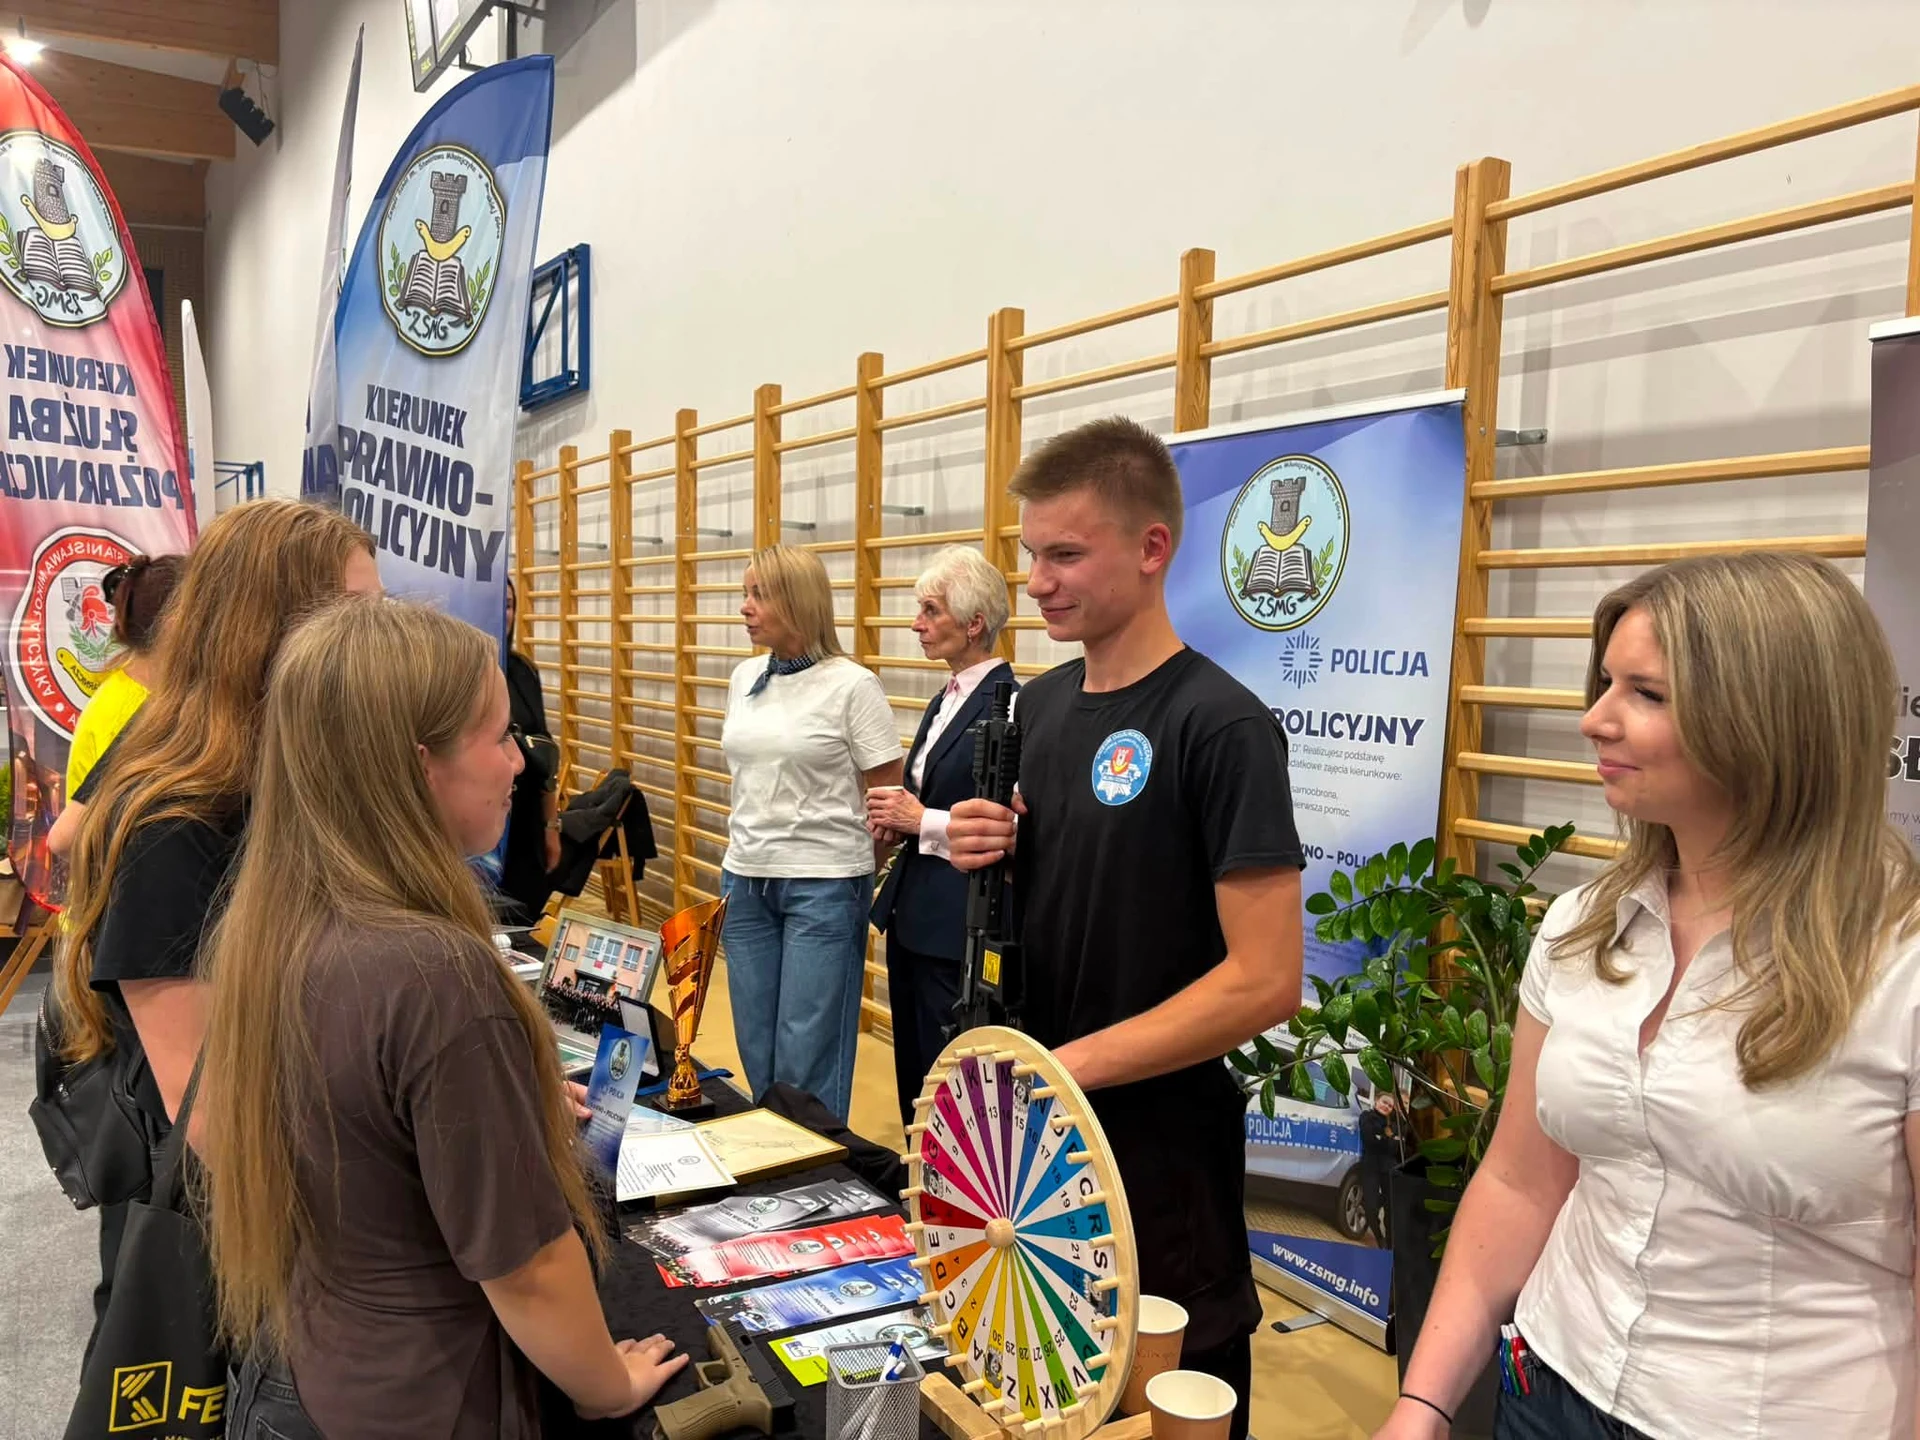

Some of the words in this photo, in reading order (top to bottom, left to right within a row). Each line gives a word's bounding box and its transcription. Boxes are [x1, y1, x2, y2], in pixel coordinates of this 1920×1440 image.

[409, 314, 448, 341] ZSMG
[366, 384, 468, 449] KIERUNEK
[338, 425, 494, 518] PRAWNO-
[340, 486, 505, 583] OLICYJNY
[1254, 595, 1297, 618] ZSMG
[1331, 648, 1429, 677] POLICJA
[1303, 744, 1343, 759] Realizujesz
[1344, 750, 1385, 764] podstawę
[1323, 763, 1349, 775] zajęcia
[1350, 765, 1403, 781] kierunkowe:
[1293, 799, 1323, 812] ierwsza
[967, 1066, 979, 1088] K
[983, 1063, 993, 1084] L
[955, 1078, 963, 1100] J
[988, 1106, 998, 1119] 13
[932, 1113, 945, 1137] H
[966, 1116, 975, 1130] 11
[1015, 1115, 1025, 1131] 15
[1248, 1119, 1293, 1140] POLICJA
[928, 1140, 939, 1159] G
[1040, 1145, 1051, 1160] 17
[1050, 1166, 1062, 1184] 18
[945, 1185, 952, 1195] 7
[1060, 1190, 1071, 1208] 19
[1066, 1216, 1078, 1235] 20
[1087, 1214, 1103, 1234] R
[928, 1231, 940, 1248] E
[948, 1232, 956, 1241] 5
[1071, 1242, 1080, 1260] 21
[1093, 1250, 1108, 1269] S
[936, 1262, 947, 1280] D
[1272, 1242, 1380, 1307] www.zsmg.info
[944, 1290, 956, 1310] C
[1068, 1291, 1079, 1312] 23
[957, 1317, 969, 1340] B
[992, 1329, 1003, 1346] 30
[1054, 1328, 1065, 1348] 25
[973, 1338, 983, 1361] A
[1005, 1340, 1016, 1356] 29
[1018, 1347, 1029, 1361] 28
[1032, 1346, 1043, 1362] 27
[1043, 1341, 1054, 1358] 26
[1006, 1374, 1017, 1400] Z
[1025, 1384, 1035, 1409] Y
[1040, 1384, 1054, 1410] X
[1053, 1379, 1073, 1407] W
